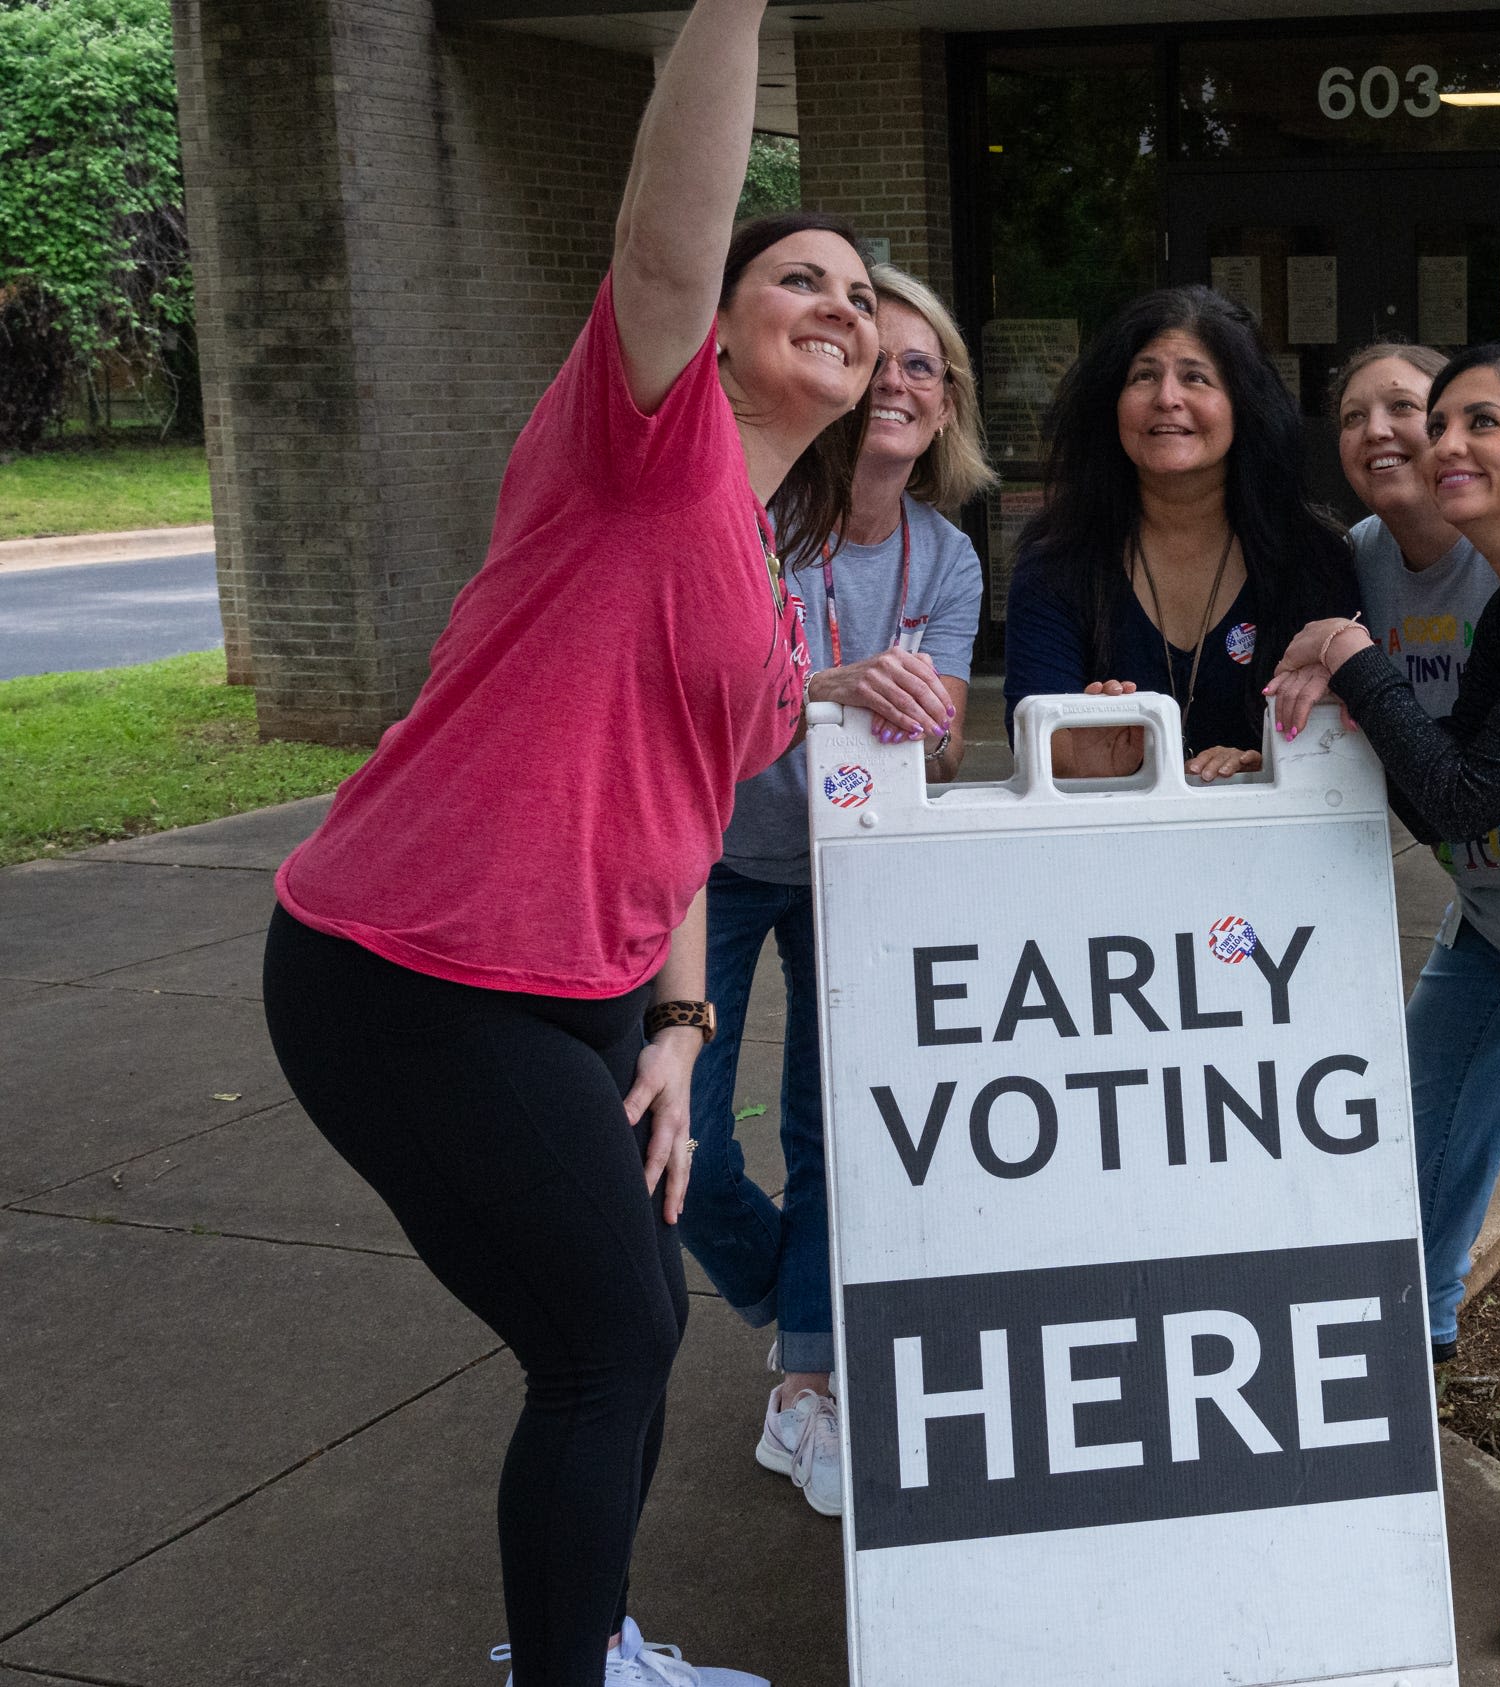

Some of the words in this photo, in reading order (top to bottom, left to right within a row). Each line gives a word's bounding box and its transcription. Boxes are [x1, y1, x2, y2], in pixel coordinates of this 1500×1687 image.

[1317, 64, 1441, 119] 603
[1406, 654, 1451, 683] TINY
[837, 772, 858, 789] VOTED
[845, 776, 865, 792] EARLY
[1218, 933, 1236, 952] EARLY
[1226, 935, 1244, 954] VOTED
[913, 926, 1316, 1047] EARLY
[868, 1053, 1381, 1187] VOTING
[893, 1296, 1390, 1489] HERE
